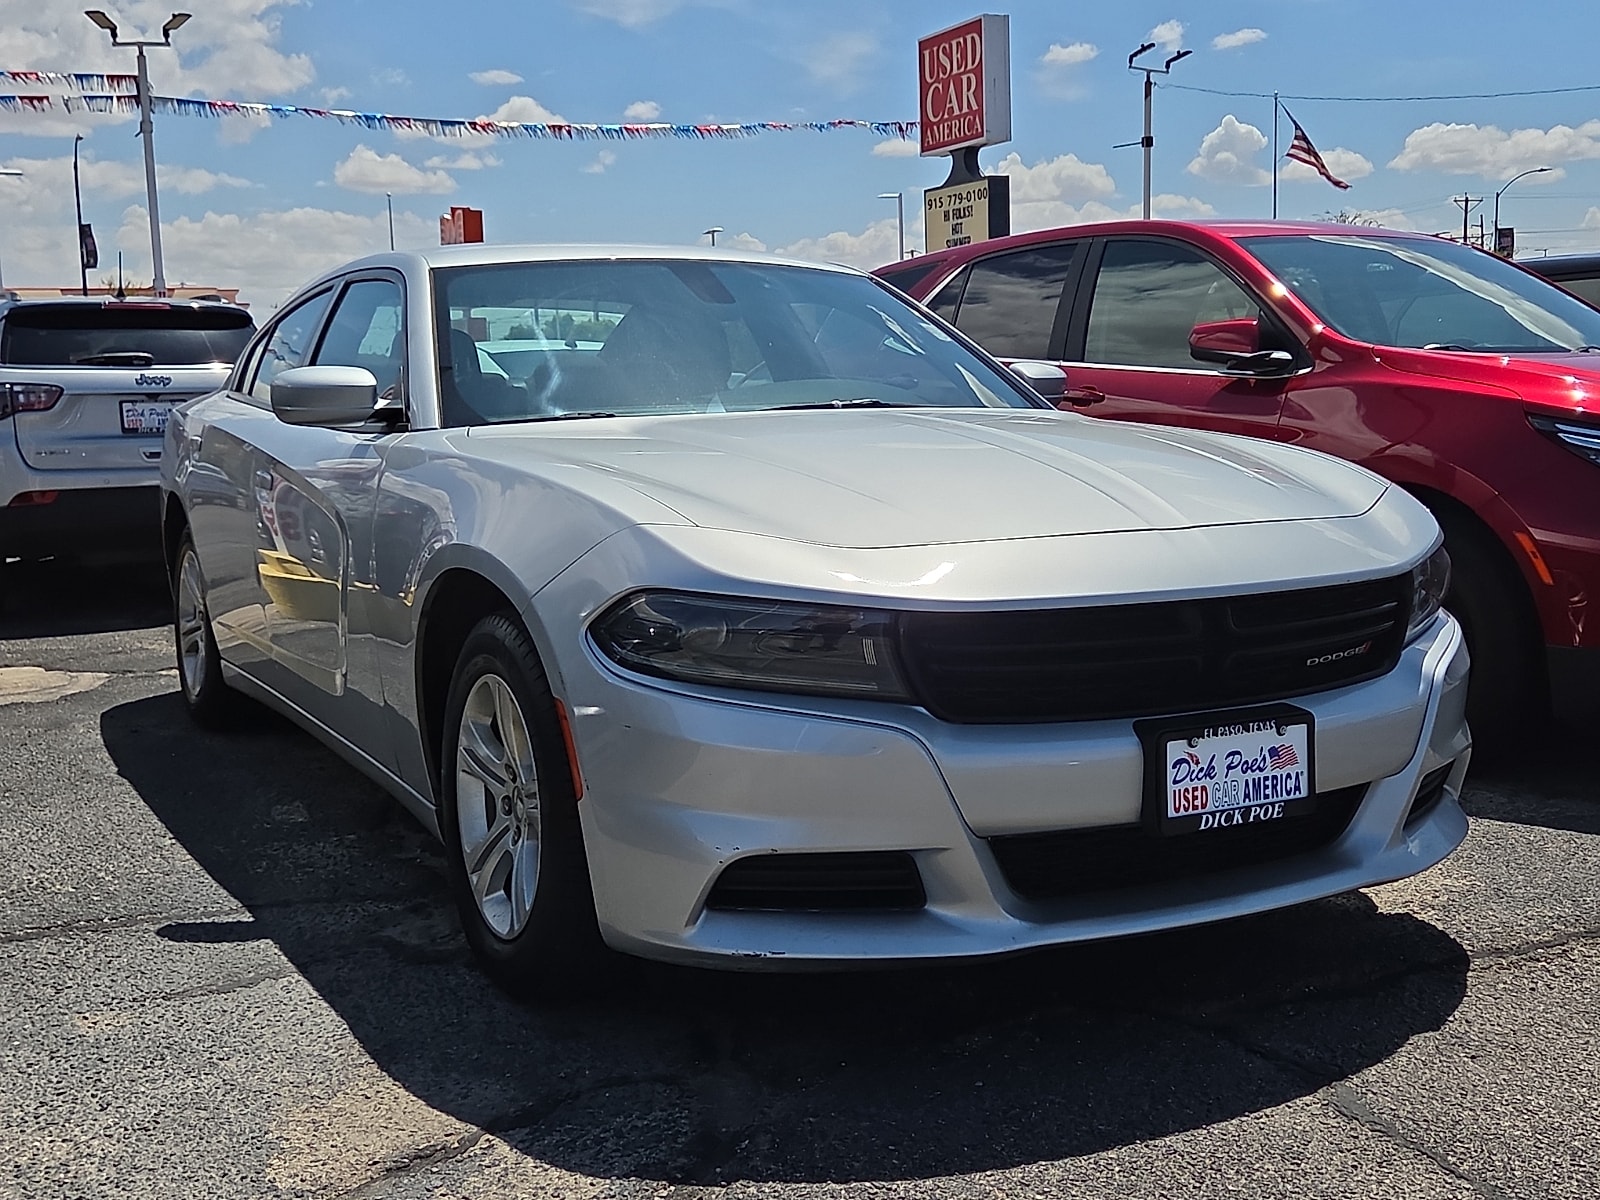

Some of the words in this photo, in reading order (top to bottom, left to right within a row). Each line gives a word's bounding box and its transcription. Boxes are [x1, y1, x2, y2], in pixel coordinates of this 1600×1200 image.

[923, 32, 981, 83] USED
[926, 73, 979, 122] CAR
[924, 114, 982, 147] AMERICA
[927, 196, 944, 211] 915
[947, 187, 988, 207] 779-0100
[943, 209, 950, 222] HI
[952, 205, 973, 221] FOLKS!
[951, 222, 963, 236] HOT
[134, 373, 172, 387] Jeep
[1306, 645, 1366, 667] DODGE
[1204, 728, 1213, 739] EL
[1249, 719, 1276, 734] TEXAS
[1171, 753, 1217, 785] Dick
[1224, 746, 1268, 779] Poe's
[1172, 785, 1208, 814] USED
[1212, 779, 1240, 809] CAR
[1243, 771, 1302, 804] AMERICA
[1199, 808, 1244, 830] DICK
[1248, 802, 1284, 823] POE
